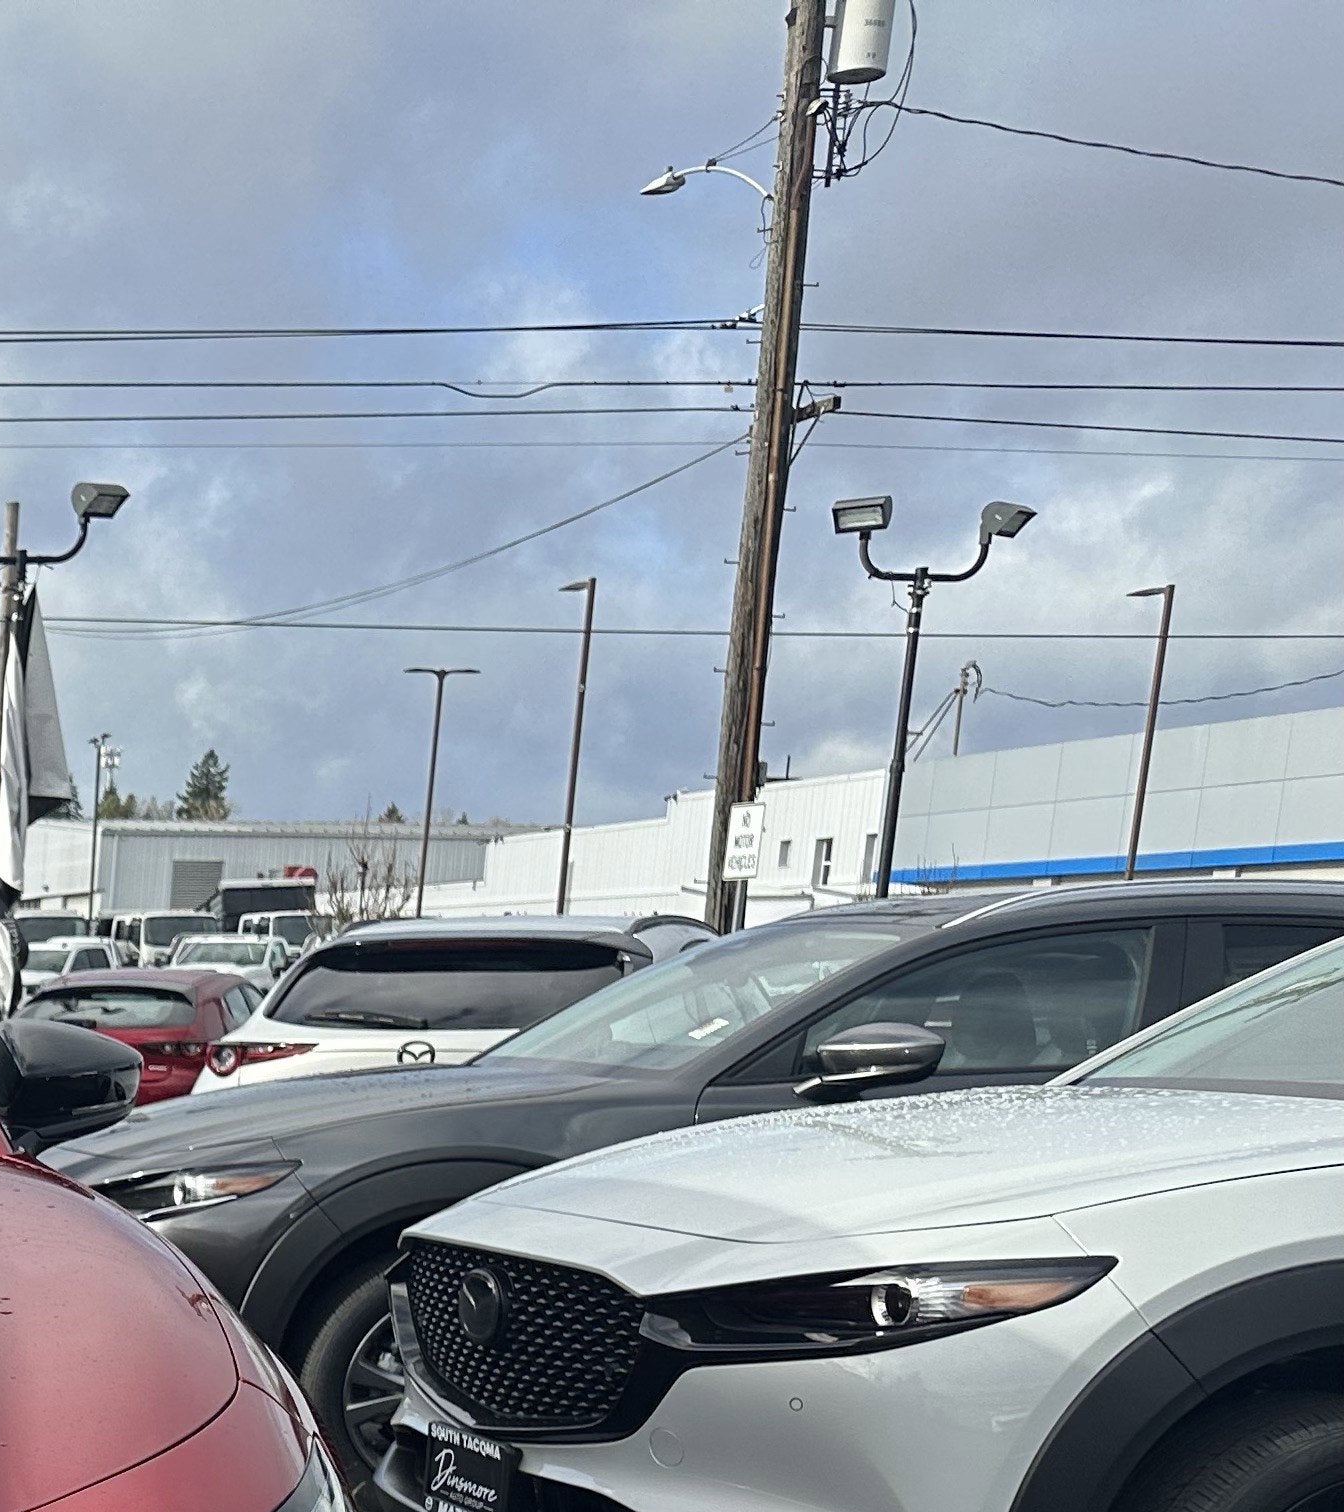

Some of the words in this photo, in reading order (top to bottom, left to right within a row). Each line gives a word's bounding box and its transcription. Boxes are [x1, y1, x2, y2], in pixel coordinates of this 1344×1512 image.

[431, 1423, 461, 1446] SOUTH
[461, 1434, 501, 1460] TACOMA
[431, 1448, 498, 1502] Dinsmore
